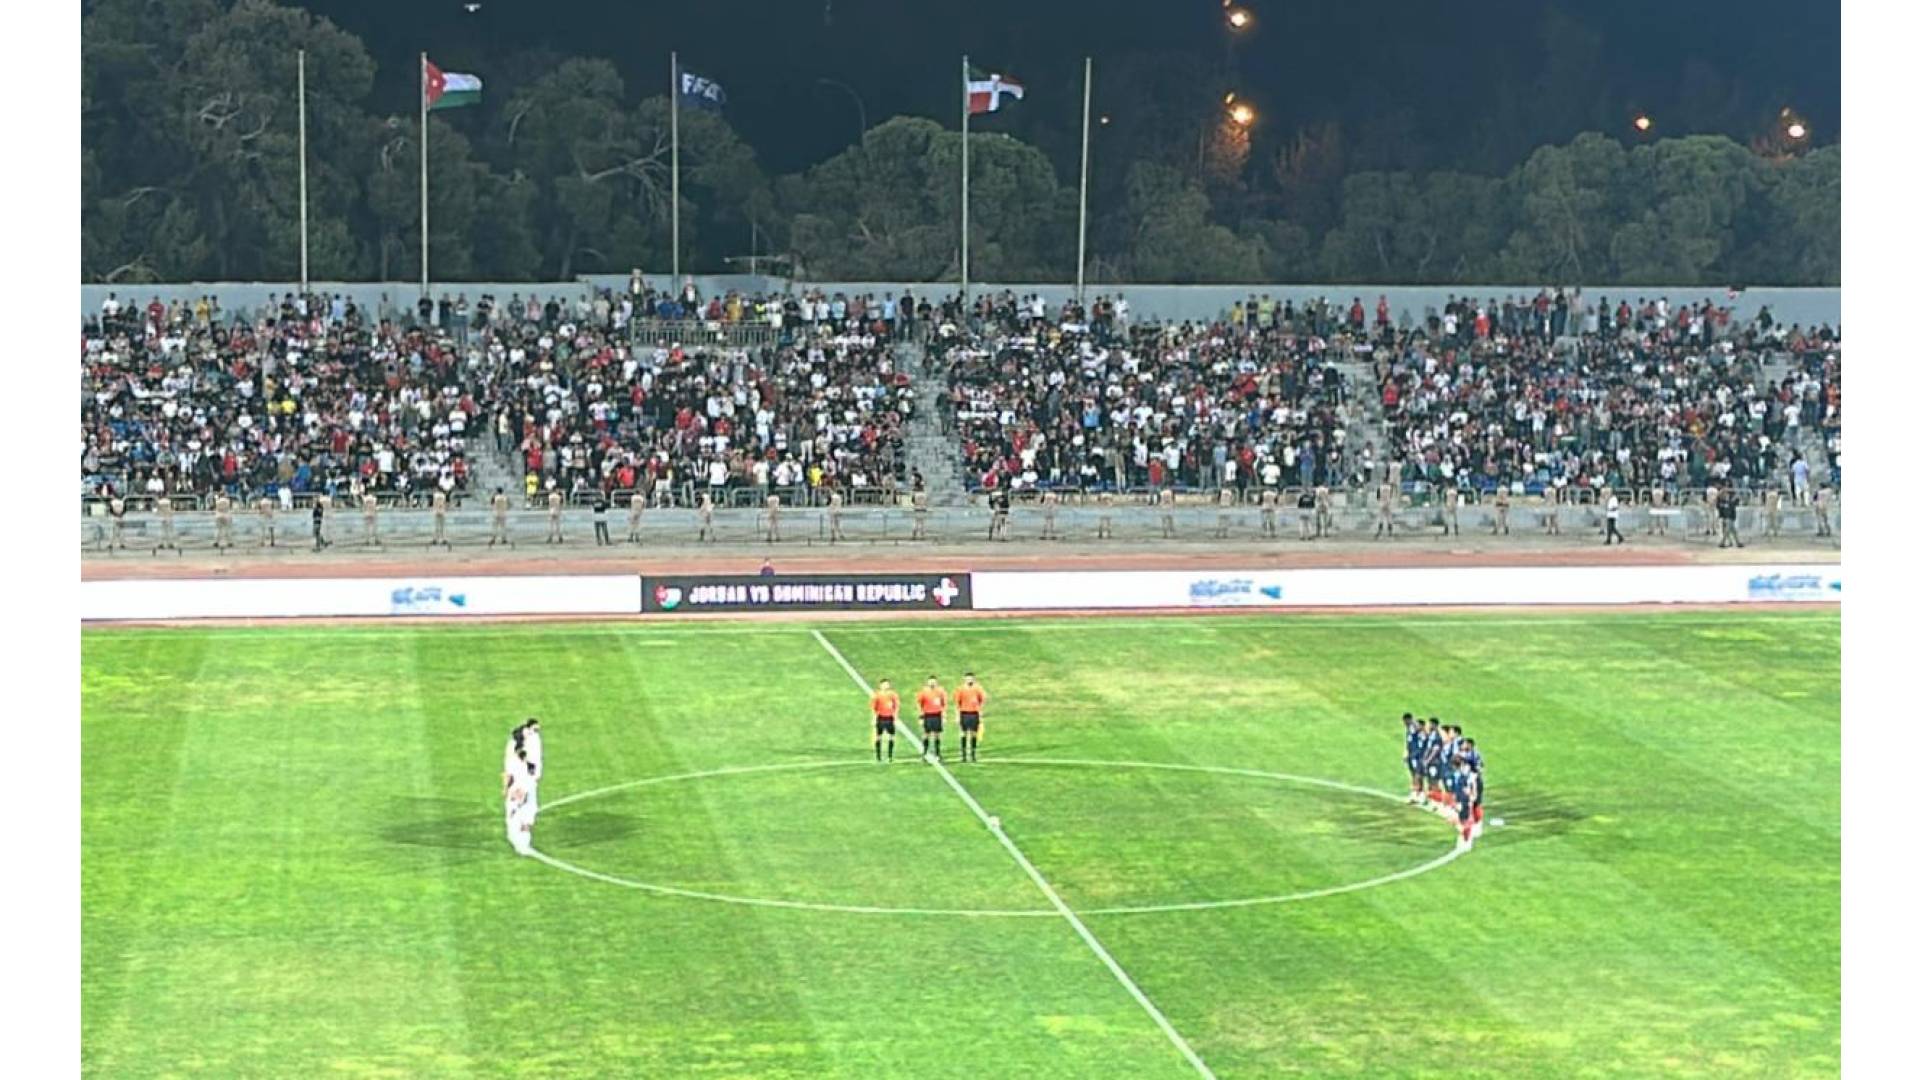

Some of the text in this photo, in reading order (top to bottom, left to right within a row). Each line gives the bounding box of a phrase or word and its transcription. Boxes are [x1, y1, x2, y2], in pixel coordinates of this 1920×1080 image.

[689, 584, 926, 603] JORDAN VS DOMINICAN REPUBLIC
